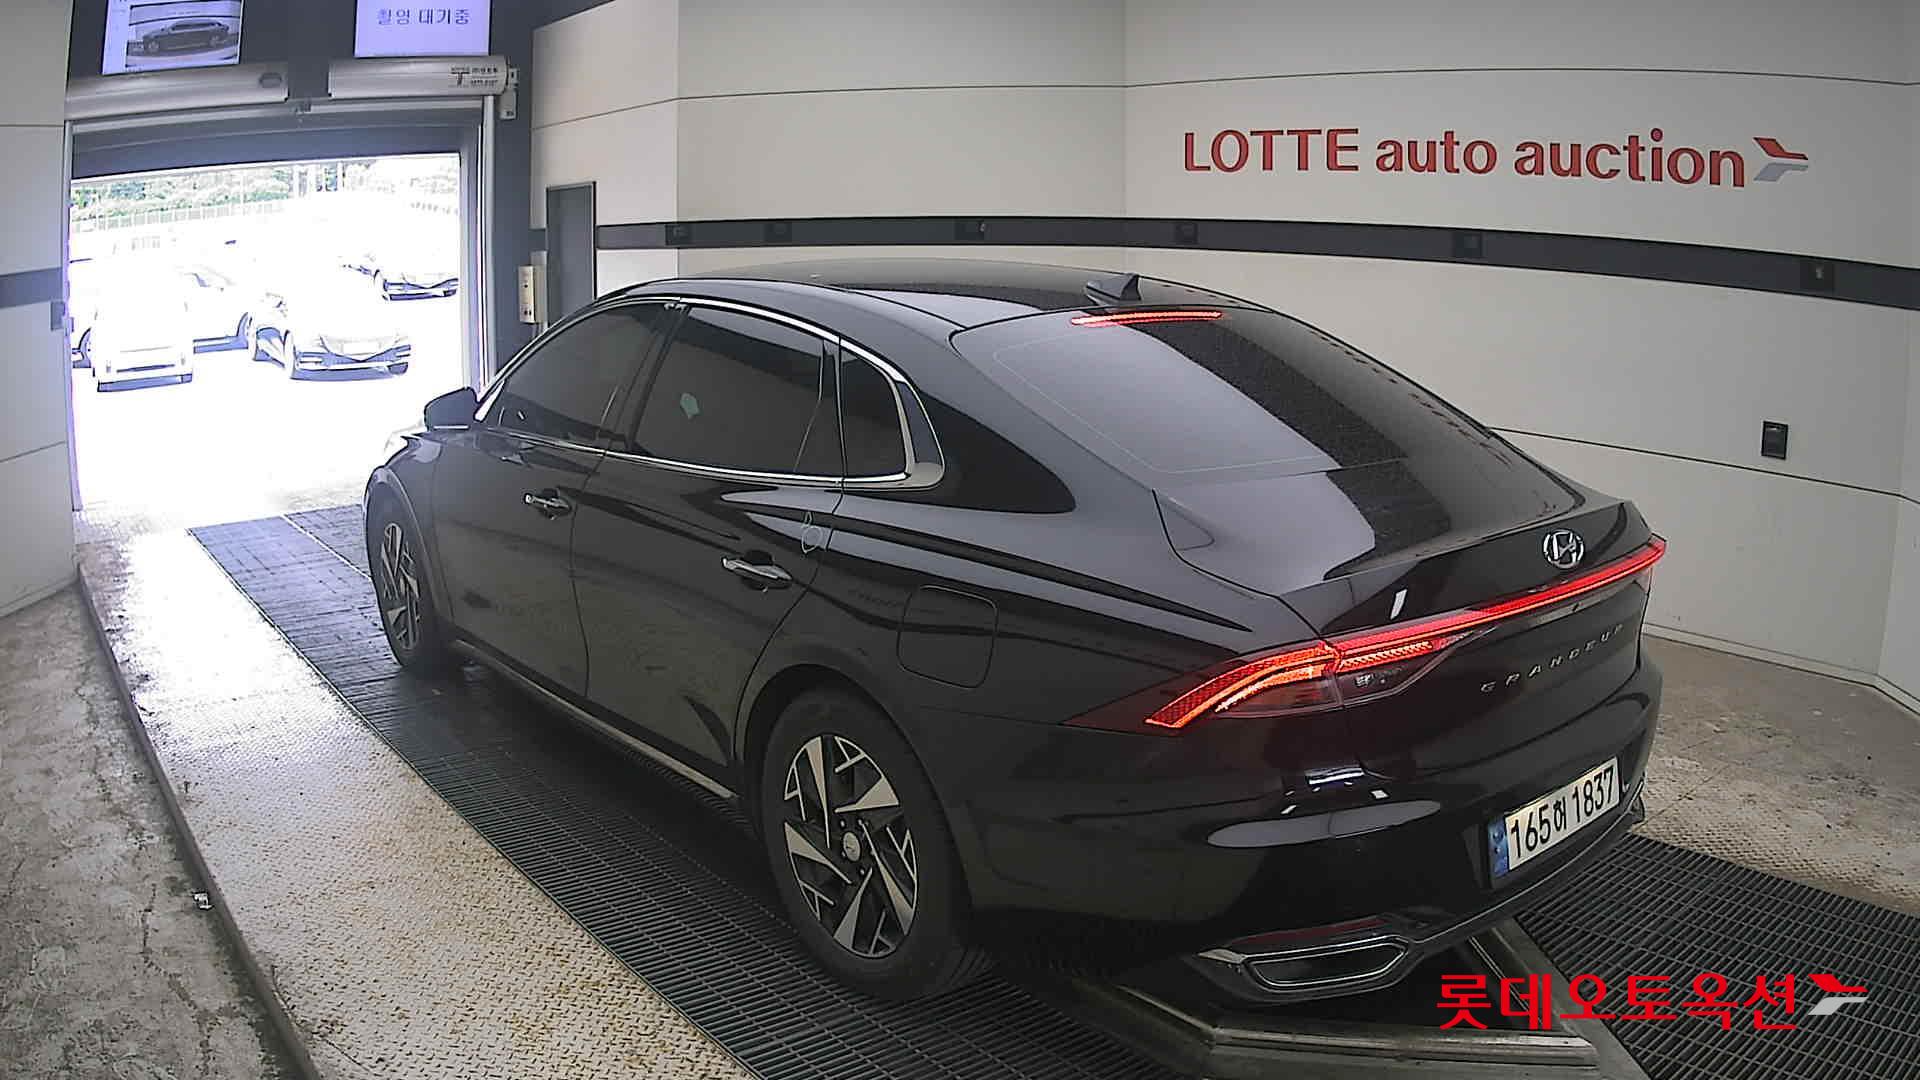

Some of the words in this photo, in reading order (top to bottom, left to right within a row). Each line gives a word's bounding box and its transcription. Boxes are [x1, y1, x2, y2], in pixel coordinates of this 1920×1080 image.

[418, 8, 470, 25] 대기중
[1184, 128, 1359, 172] LOTTE
[1376, 130, 1498, 174] auto
[1514, 128, 1745, 187] auction
[1479, 623, 1624, 692] GRANDEUR
[1511, 796, 1567, 858] 165허
[1571, 765, 1614, 823] 1837
